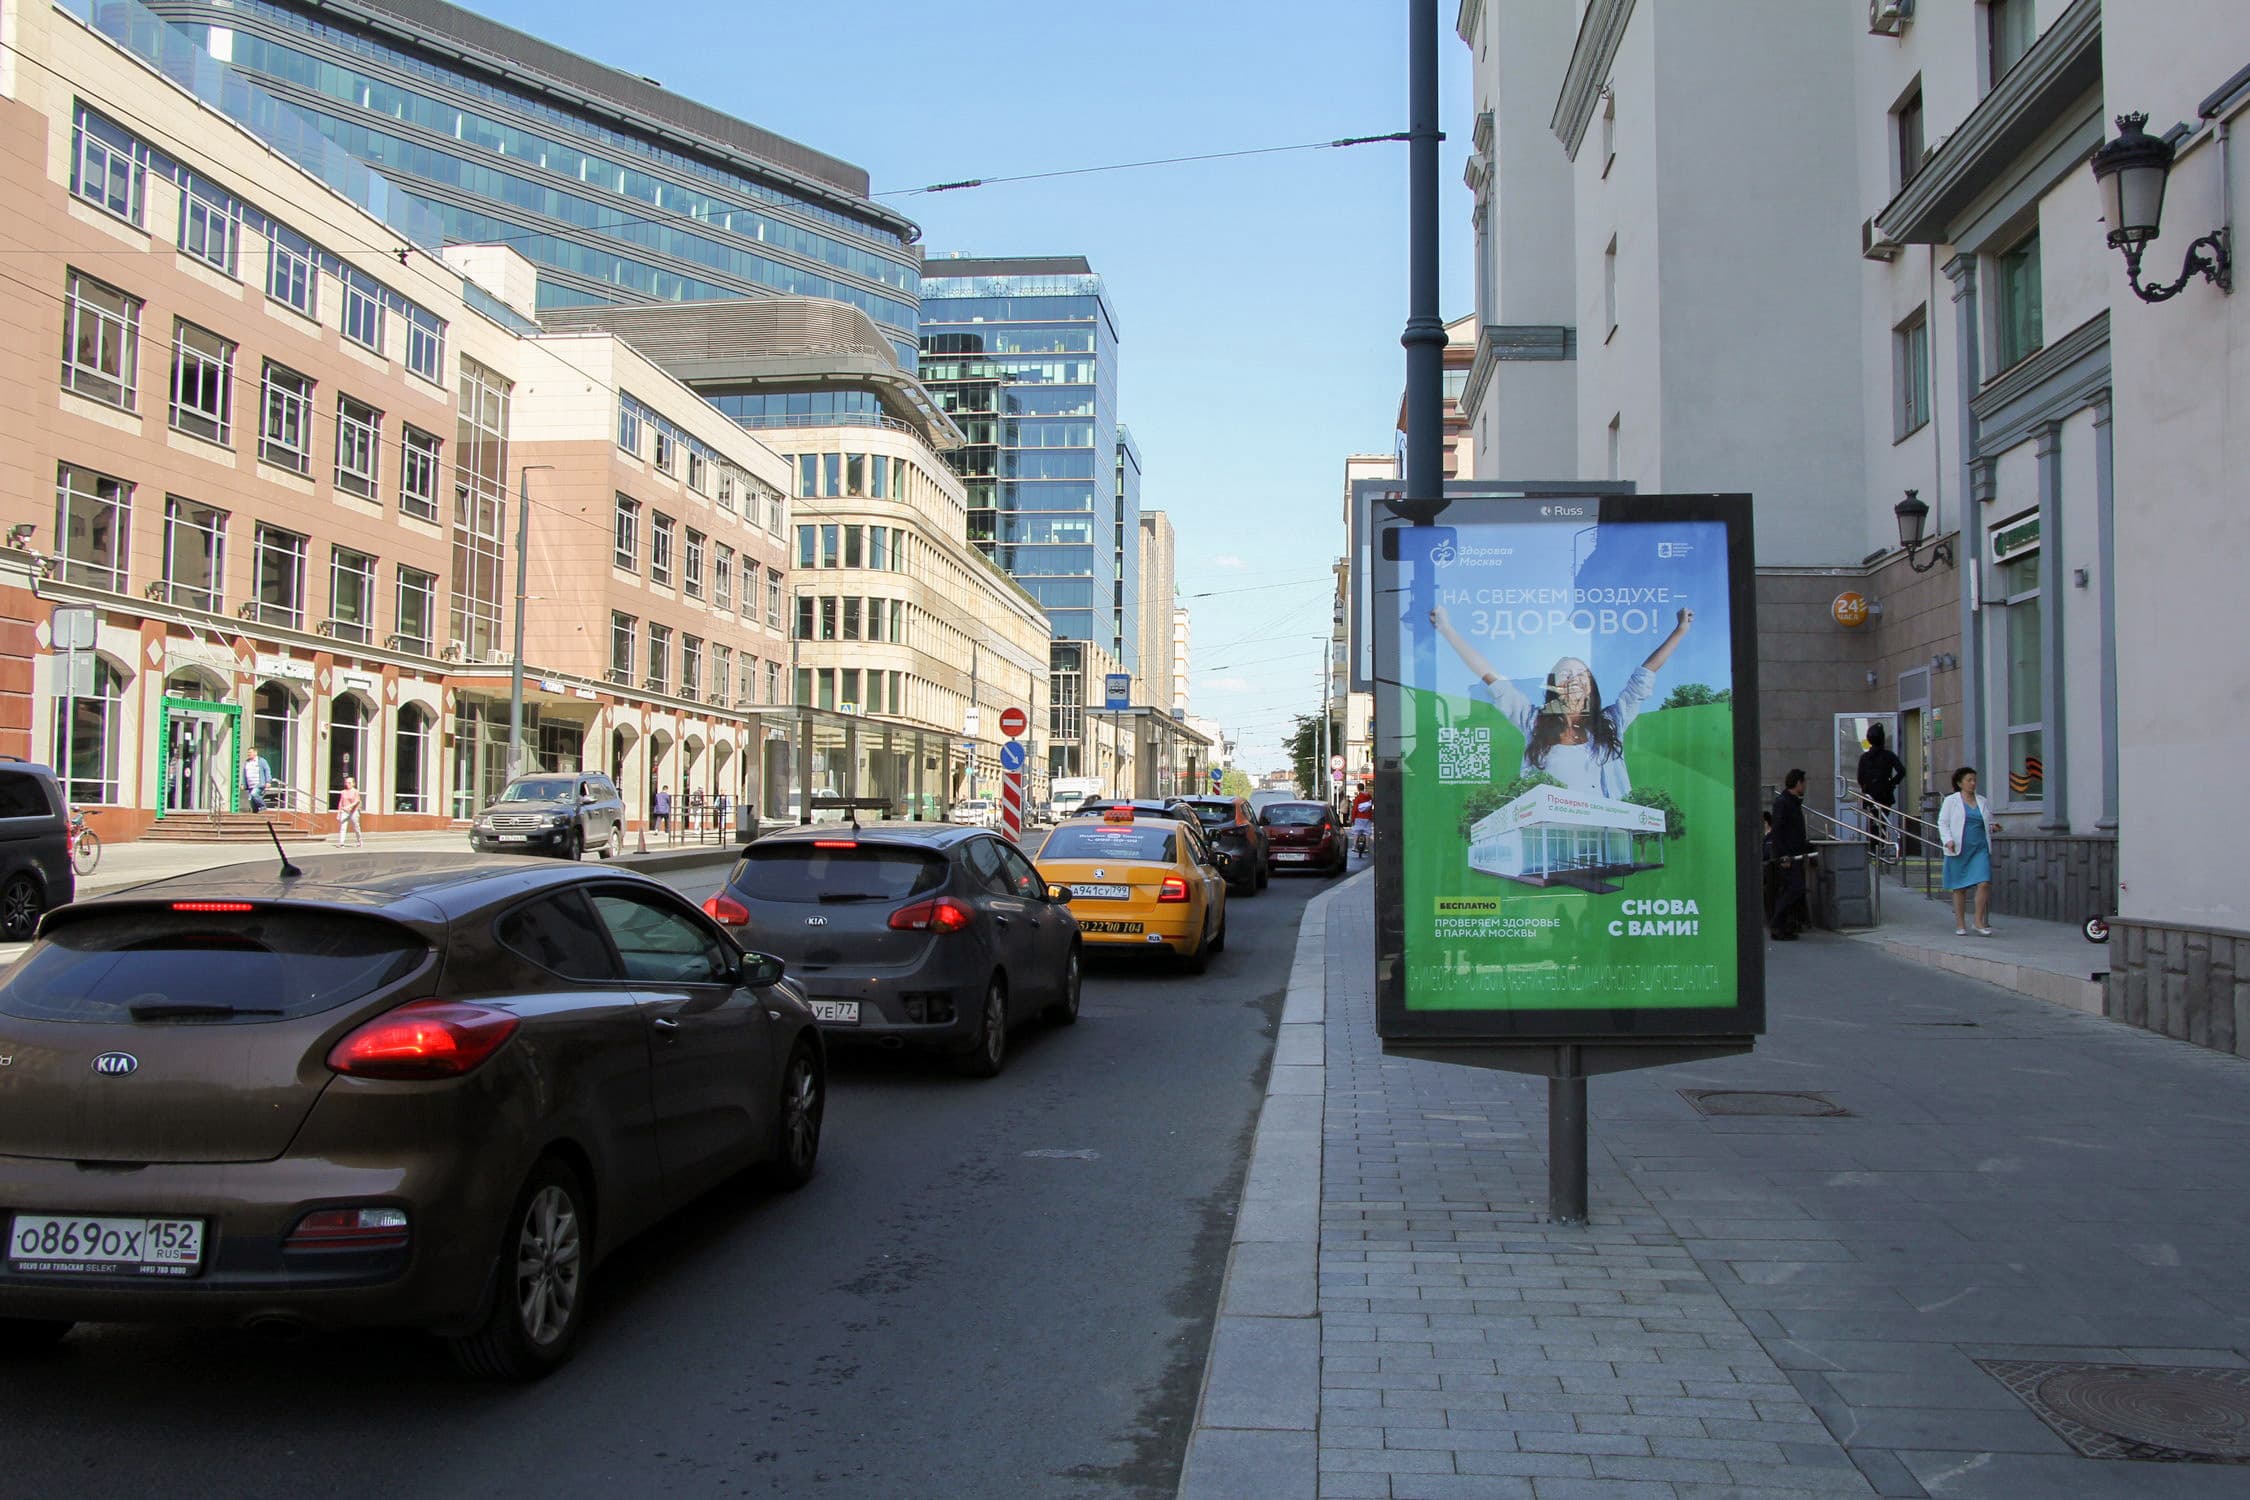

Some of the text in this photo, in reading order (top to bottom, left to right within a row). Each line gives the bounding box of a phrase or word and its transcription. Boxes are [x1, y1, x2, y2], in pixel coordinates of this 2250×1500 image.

[1554, 505, 1584, 516] Russ
[1459, 557, 1503, 567] Москва
[1443, 588, 1471, 605] НА
[1476, 588, 1568, 605] СВЕЖЕМ
[1574, 587, 1670, 606] ВОЗДУХЕ
[1838, 599, 1859, 613] 24
[1470, 608, 1660, 640] ЗДОРОВО!
[1439, 902, 1498, 910] БЕСПЛАТНО
[1621, 899, 1699, 916] СНОВА
[808, 917, 824, 926] KIA
[1434, 918, 1561, 929] ПРОВЕРЯЕМ ЗДОРОВЬЕ
[1434, 928, 1537, 938] В ПАРКАХ МОСКВЫ
[1608, 920, 1699, 936] С ВАМИ!
[96, 1057, 129, 1073] KIA
[148, 1223, 194, 1249] 152
[156, 1248, 180, 1259] RUS
[85, 1264, 117, 1273] SELEKT
